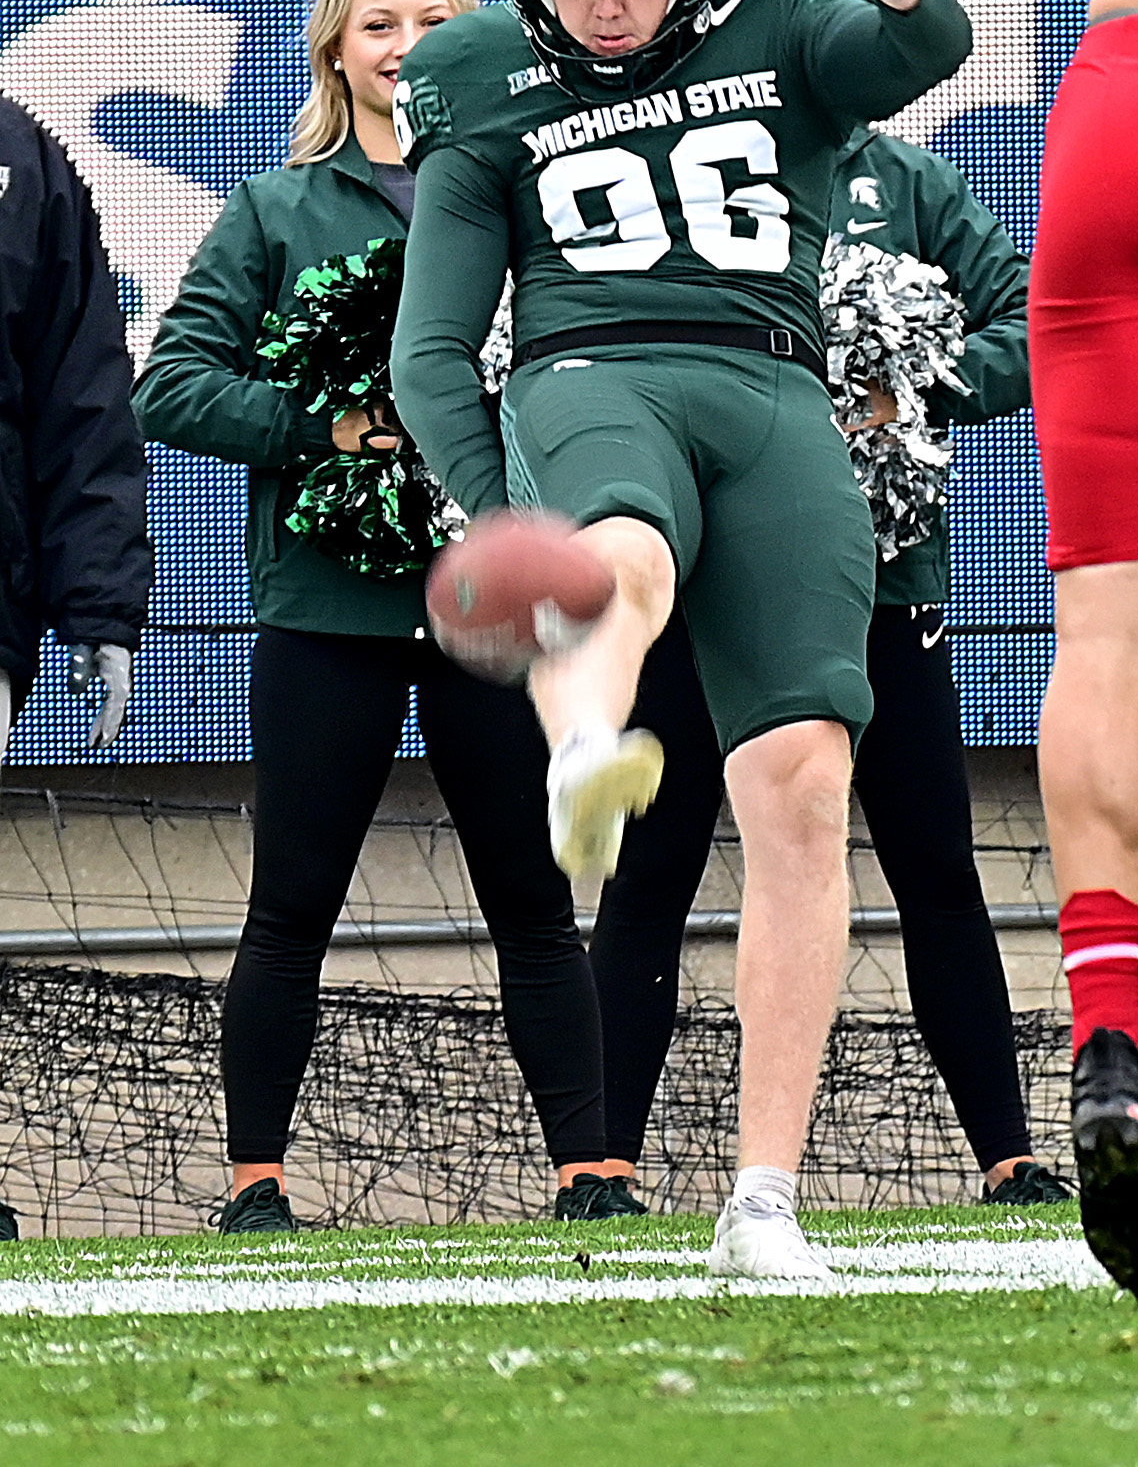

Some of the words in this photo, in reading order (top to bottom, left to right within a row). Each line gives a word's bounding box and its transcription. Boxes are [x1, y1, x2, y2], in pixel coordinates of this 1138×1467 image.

[521, 89, 683, 165] MICHIGAN
[685, 70, 783, 119] STATE
[537, 120, 791, 272] 96
